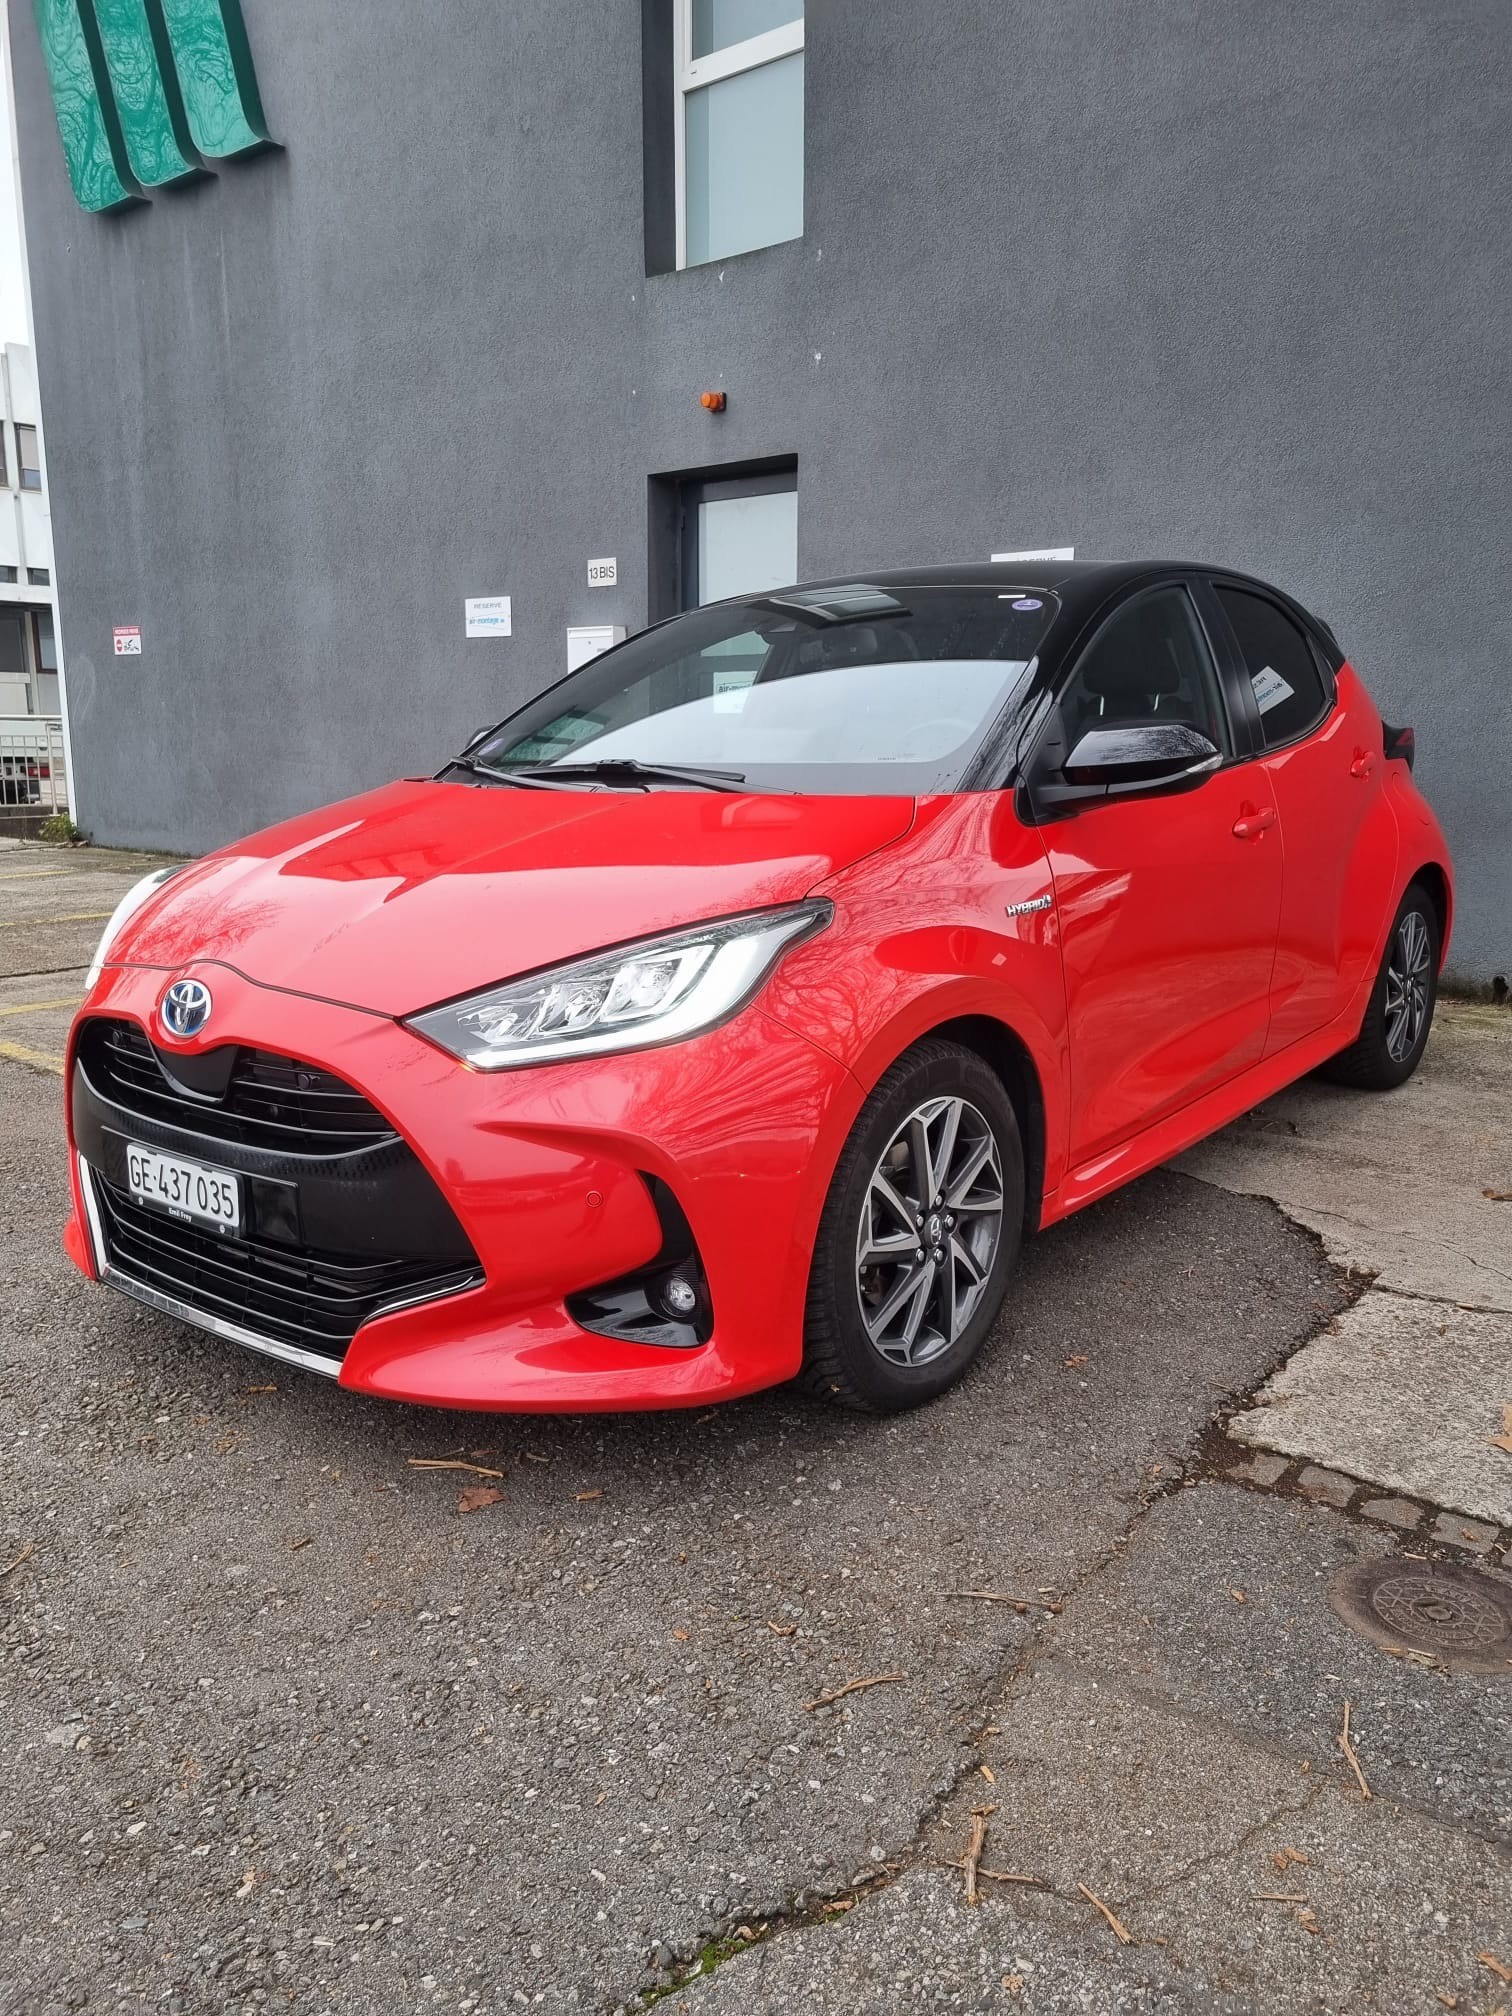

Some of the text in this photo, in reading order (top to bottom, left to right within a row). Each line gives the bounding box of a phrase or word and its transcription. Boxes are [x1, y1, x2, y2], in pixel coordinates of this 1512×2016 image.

[599, 566, 615, 579] BIS
[1006, 898, 1045, 917] HYBRID
[168, 1207, 192, 1222] Emil Frey
